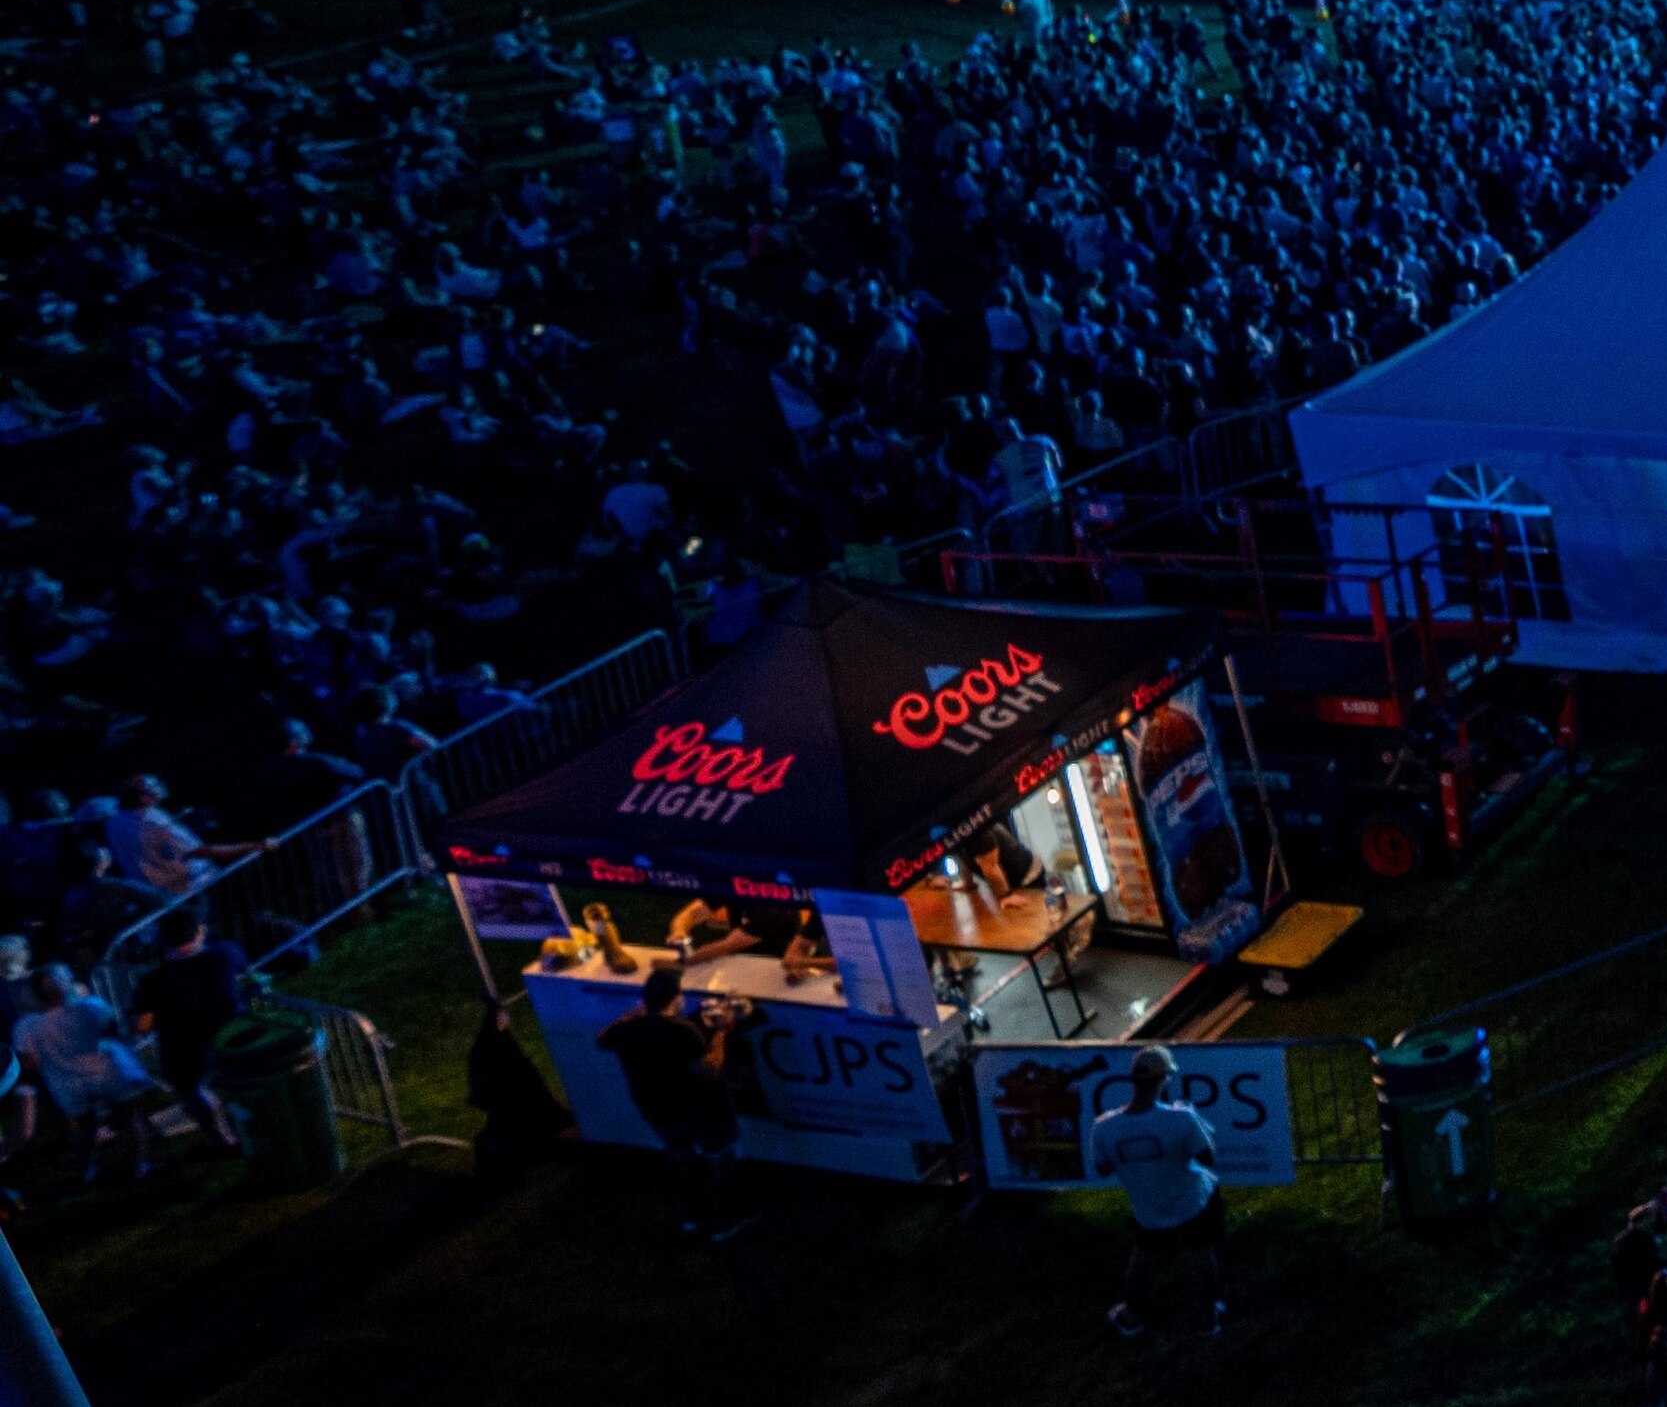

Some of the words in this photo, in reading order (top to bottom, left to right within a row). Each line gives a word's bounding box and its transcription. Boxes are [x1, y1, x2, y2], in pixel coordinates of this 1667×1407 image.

[871, 641, 1045, 751] Coors
[940, 670, 1063, 756] LIGHT
[631, 720, 798, 795] Coors
[616, 781, 757, 825] LIGHT
[884, 840, 945, 890] Coors
[943, 802, 994, 851] LIGHT
[759, 1028, 914, 1093] CJPS
[1092, 1071, 1268, 1131] CPS
